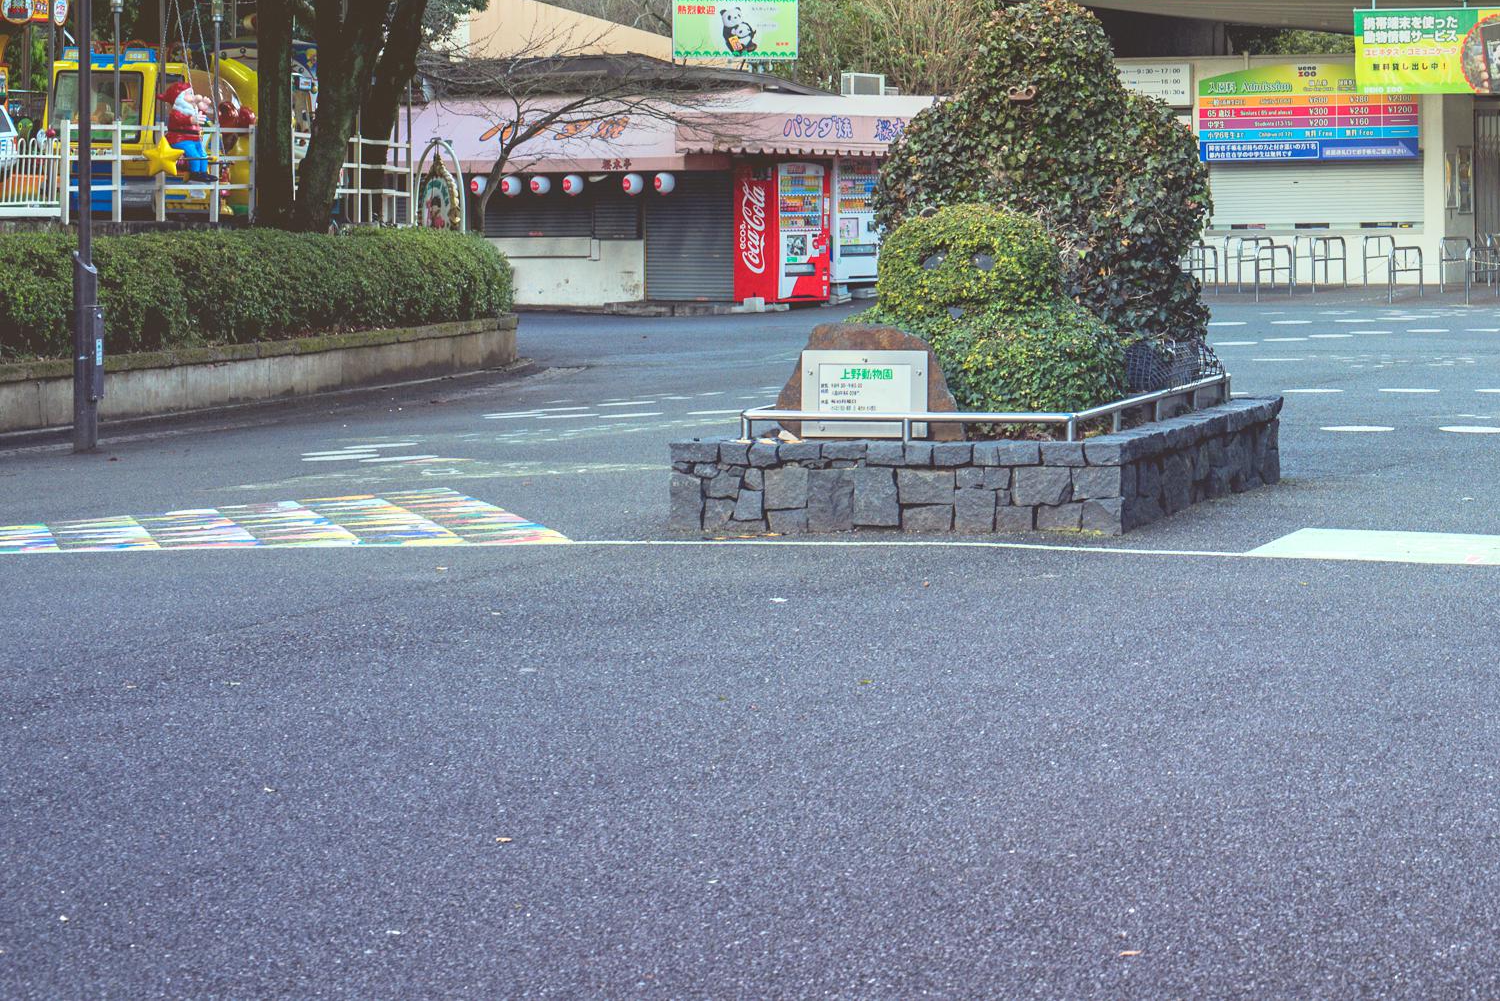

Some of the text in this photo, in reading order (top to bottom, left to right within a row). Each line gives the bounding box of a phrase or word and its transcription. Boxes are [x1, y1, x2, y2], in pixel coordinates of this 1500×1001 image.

[1363, 30, 1459, 44] 動物情報サービス
[1241, 80, 1293, 93] Admission
[1308, 107, 1329, 115] ¥300
[1350, 106, 1369, 114] ¥240
[1388, 104, 1413, 113] ¥1200
[1308, 118, 1329, 126] ¥200
[1350, 117, 1369, 125] ¥160
[783, 114, 853, 139] パンダ焼
[742, 181, 766, 274] Coca-Cola
[840, 368, 893, 380] 上野動物園
